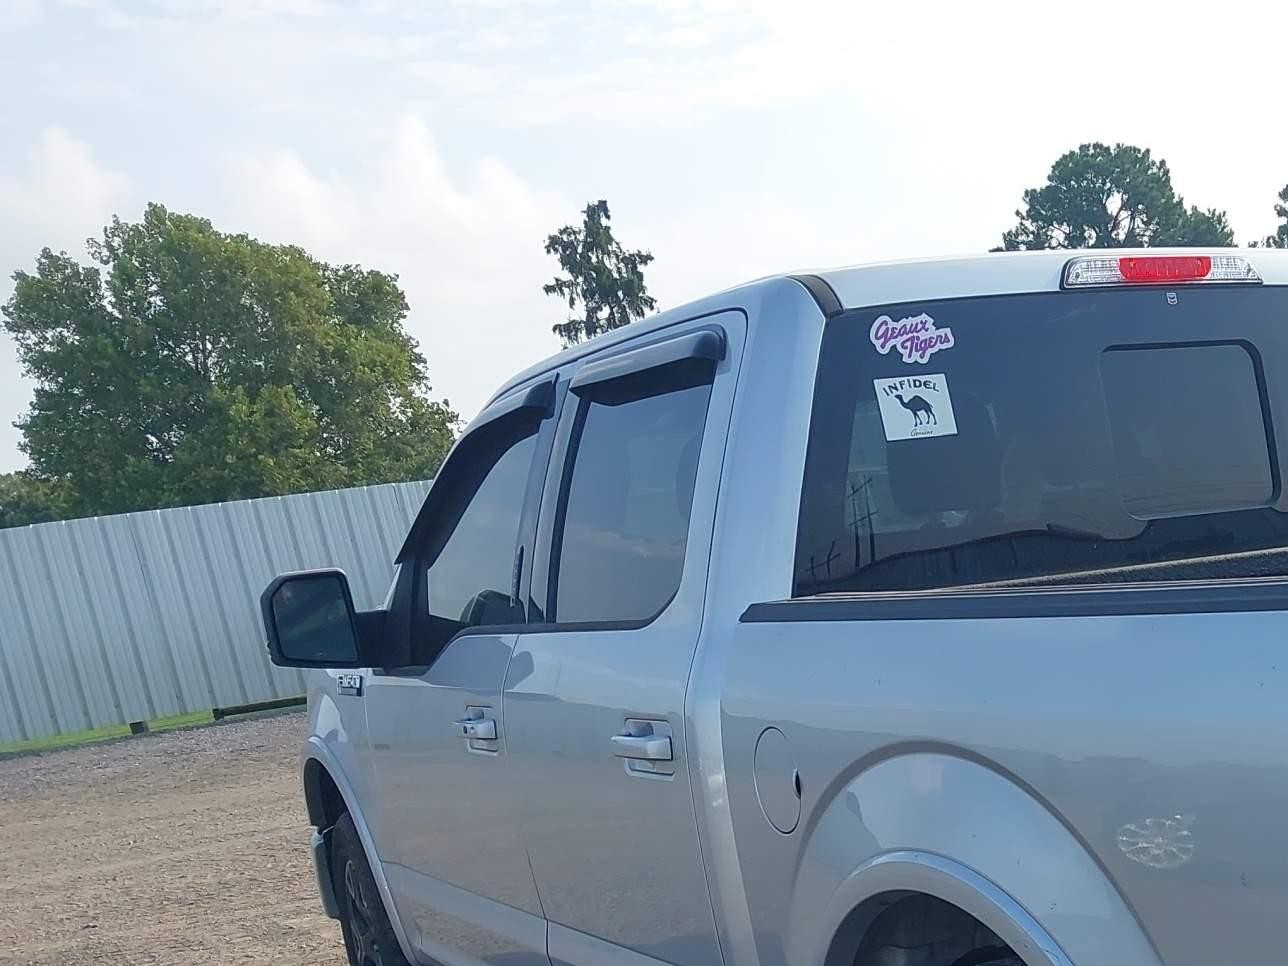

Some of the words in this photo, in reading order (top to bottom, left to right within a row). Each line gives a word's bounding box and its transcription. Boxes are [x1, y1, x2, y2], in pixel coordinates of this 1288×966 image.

[874, 319, 930, 349] Geaux
[900, 332, 951, 359] Tigers
[882, 378, 940, 397] INFIDEL
